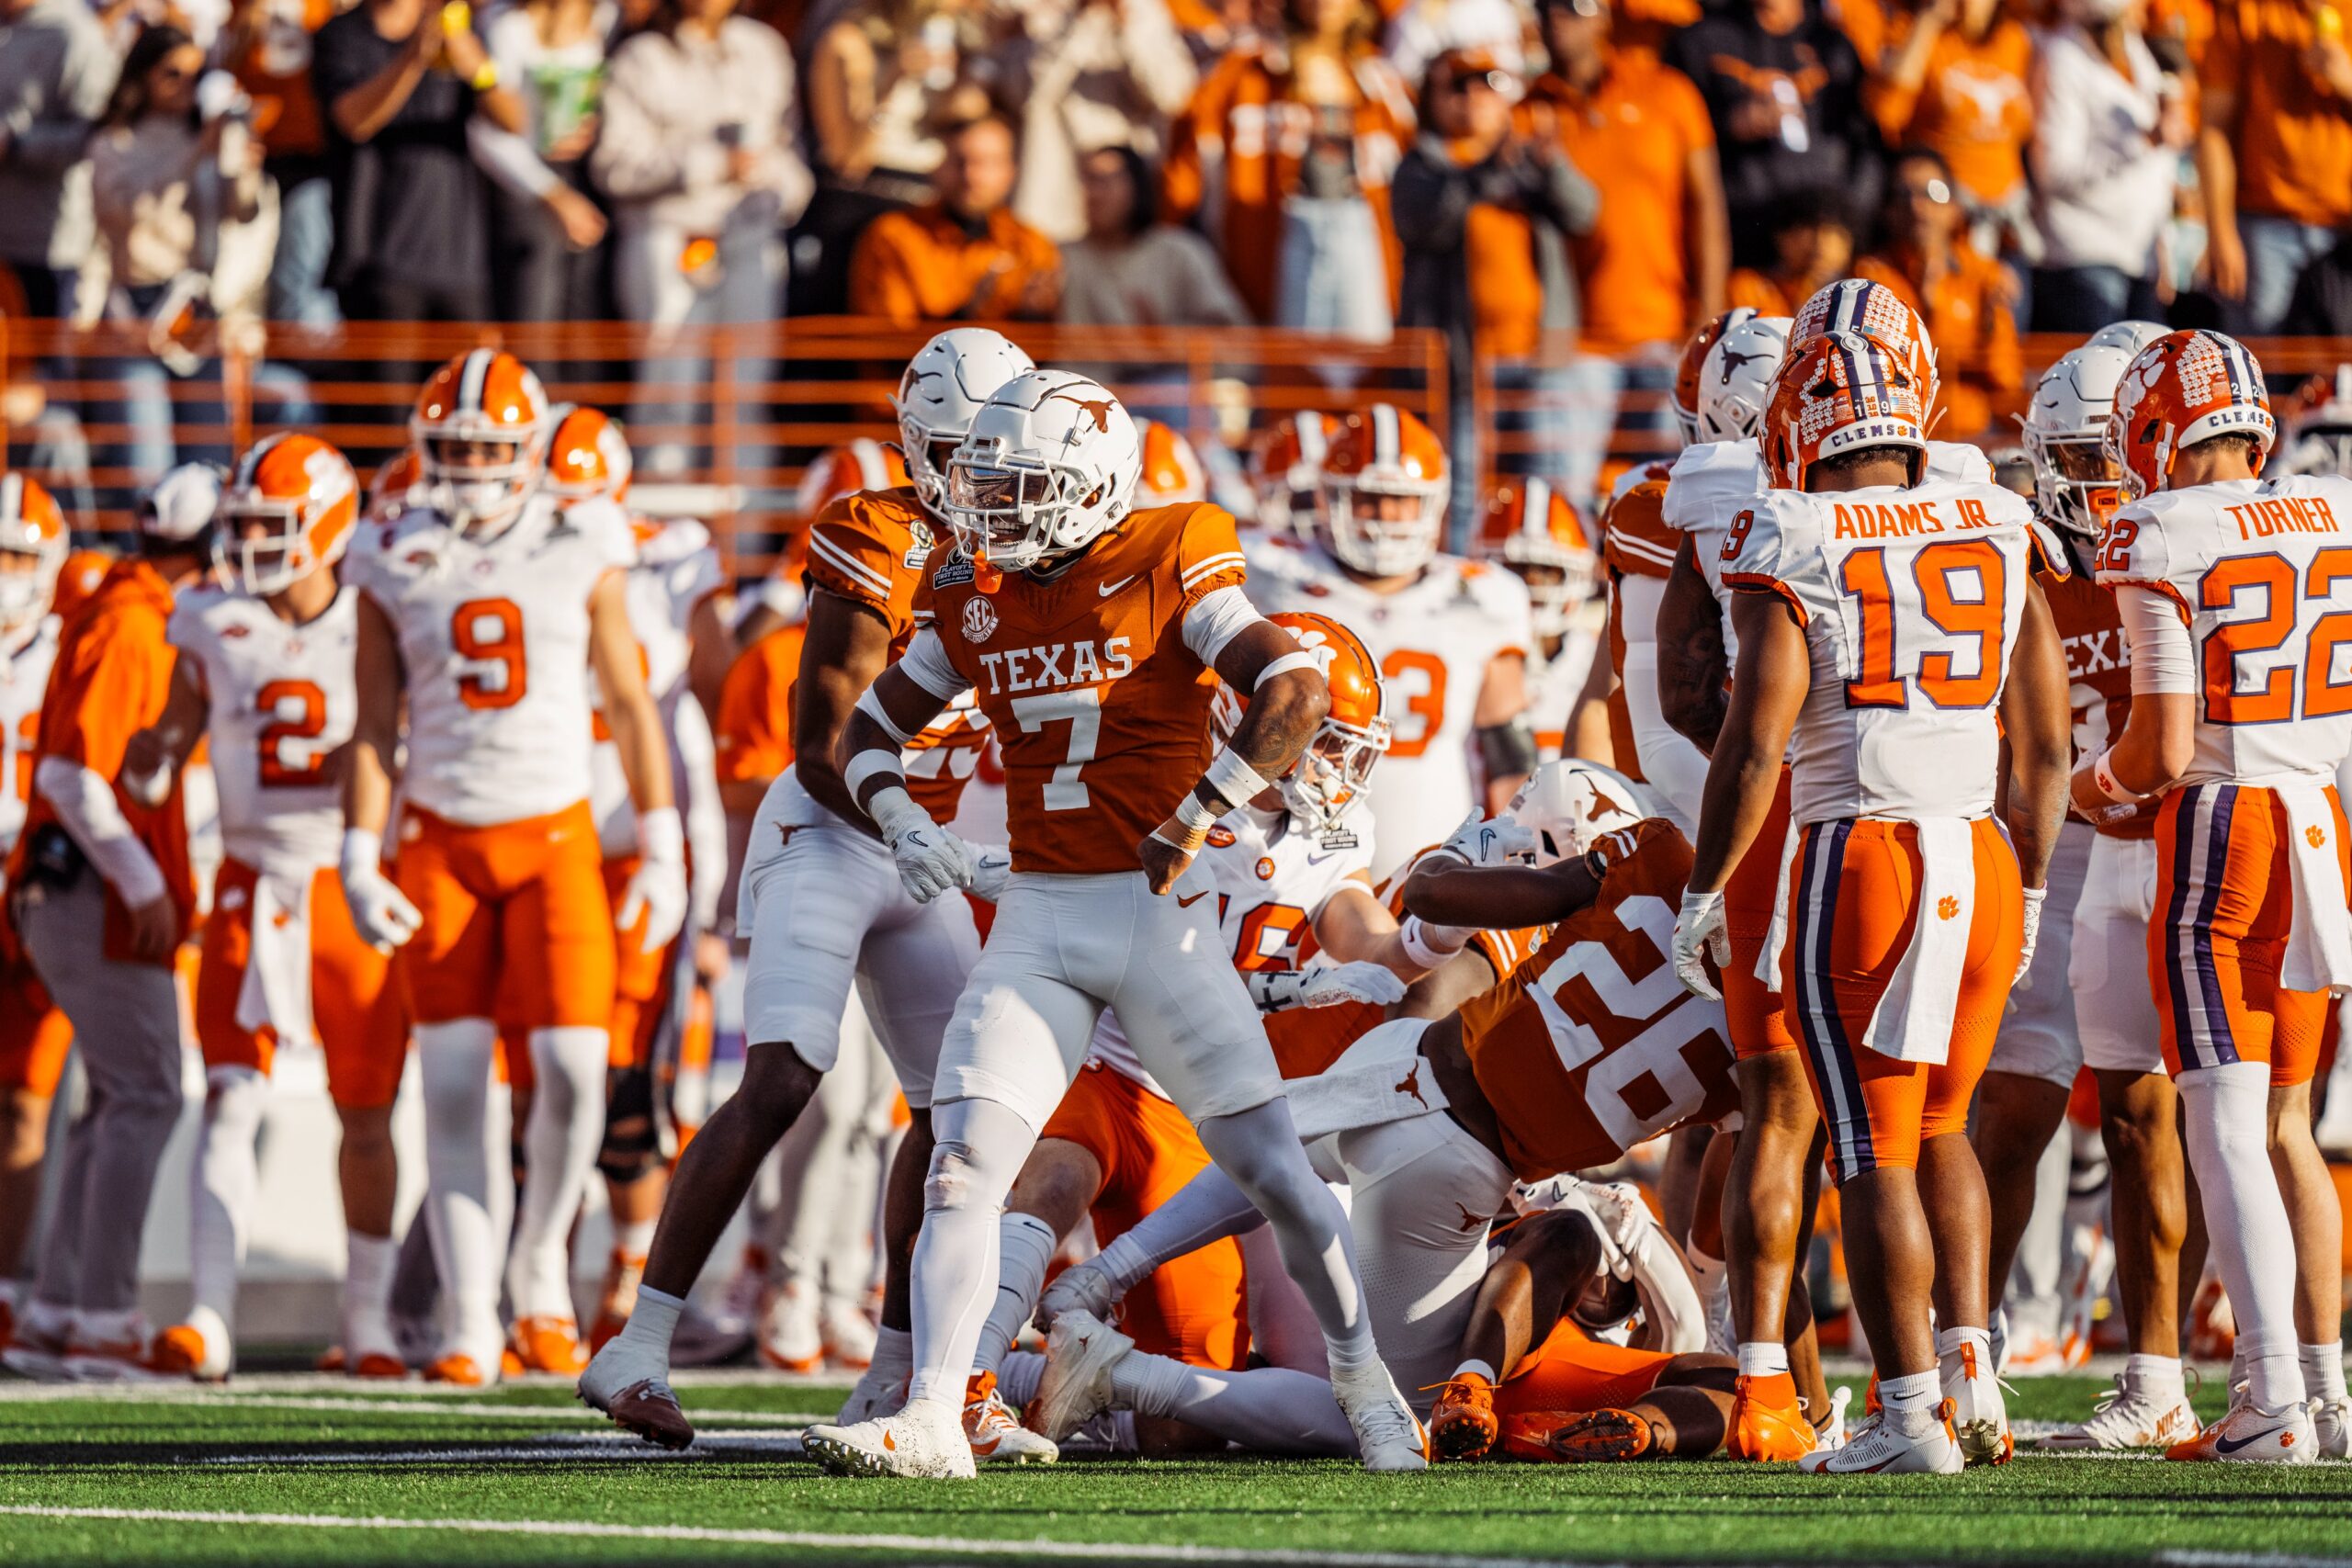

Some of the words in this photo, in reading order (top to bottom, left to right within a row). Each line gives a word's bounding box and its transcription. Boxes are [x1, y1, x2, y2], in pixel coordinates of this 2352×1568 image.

[1718, 509, 1755, 562] 9
[1833, 501, 1946, 540] ADAMS
[2093, 518, 2140, 572] 22
[2222, 497, 2340, 541] TURNER
[965, 599, 991, 631] SEC
[1838, 536, 2007, 711] 19
[2198, 545, 2352, 728] 22
[450, 596, 527, 711] 9
[978, 636, 1133, 695] TEXAS
[257, 677, 333, 788] 2
[1011, 687, 1102, 812] 7
[2154, 1404, 2185, 1440] NIKE
